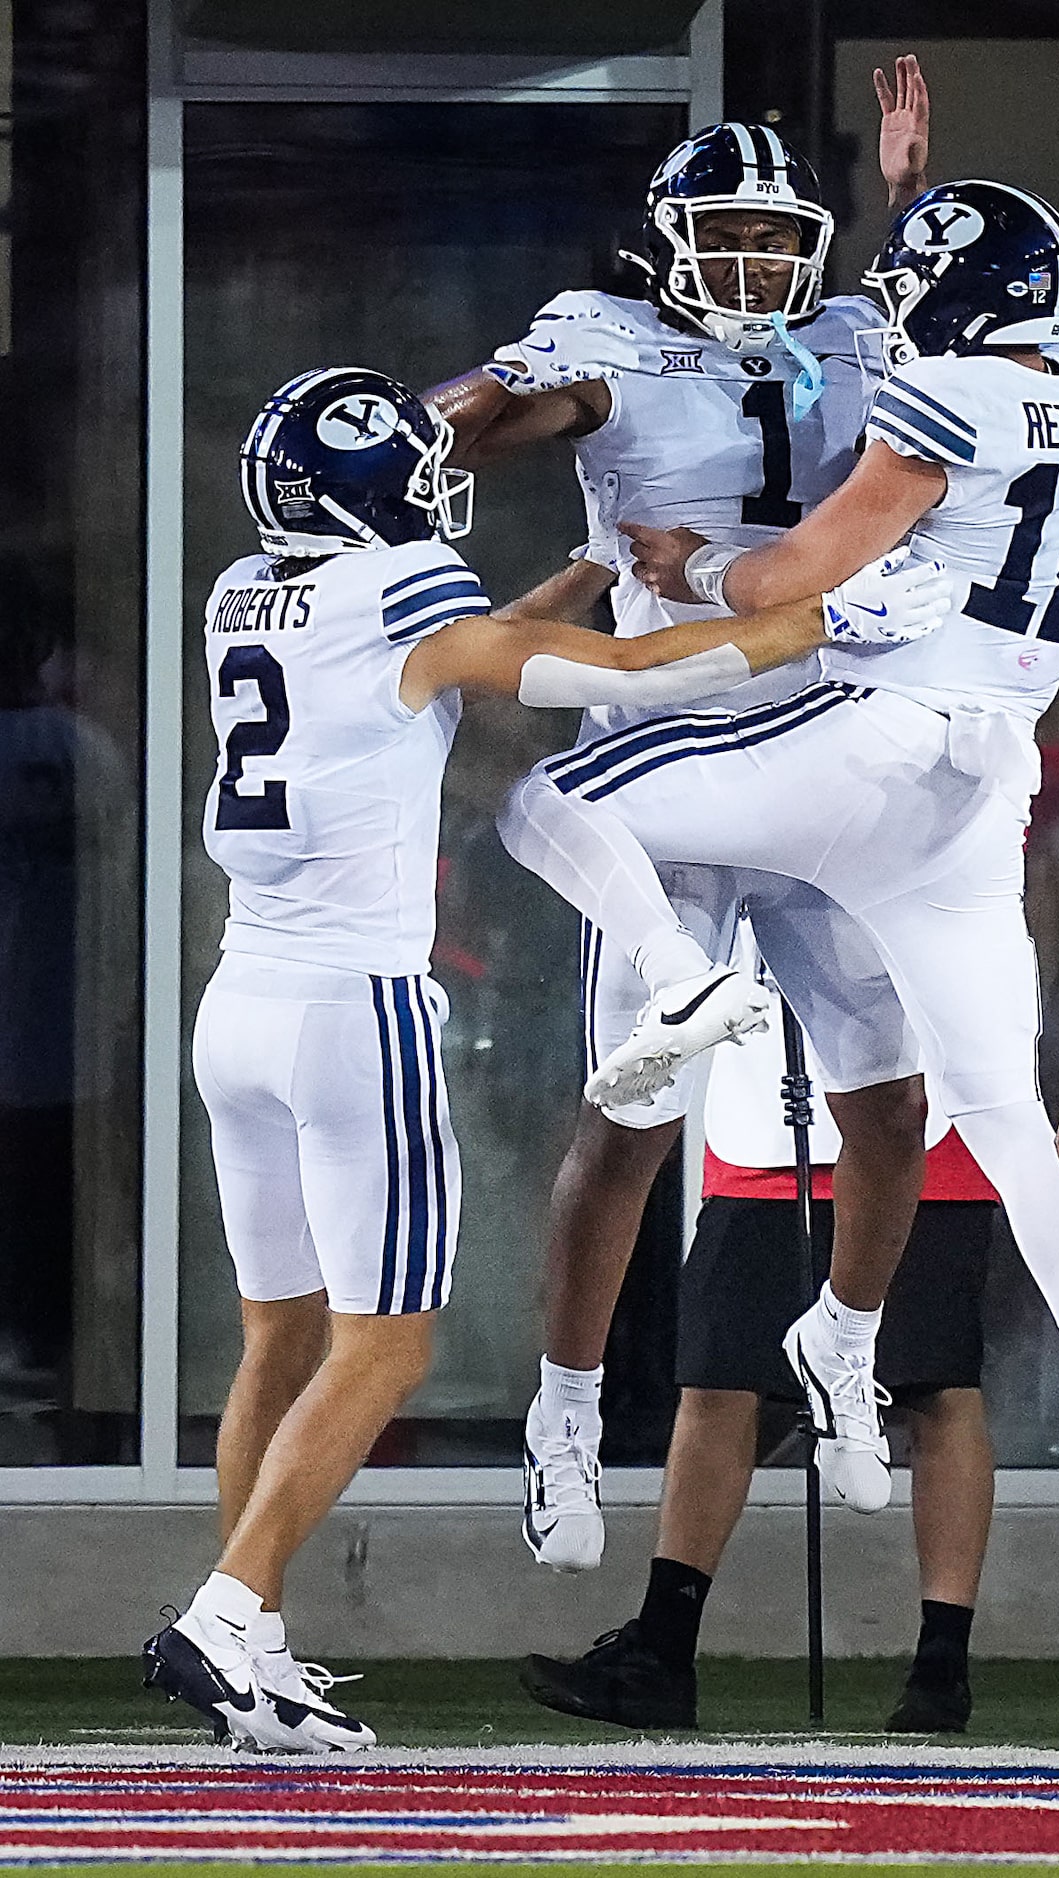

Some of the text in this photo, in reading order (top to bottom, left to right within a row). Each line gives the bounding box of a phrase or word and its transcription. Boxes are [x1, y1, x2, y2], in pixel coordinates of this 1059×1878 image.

[757, 182, 779, 194] BYU
[916, 206, 971, 246] Y
[1032, 290, 1047, 304] 12
[745, 359, 764, 374] Y
[325, 399, 380, 441] Y
[741, 380, 801, 527] 1
[212, 584, 316, 634] ROBERTS
[215, 644, 291, 831] 2
